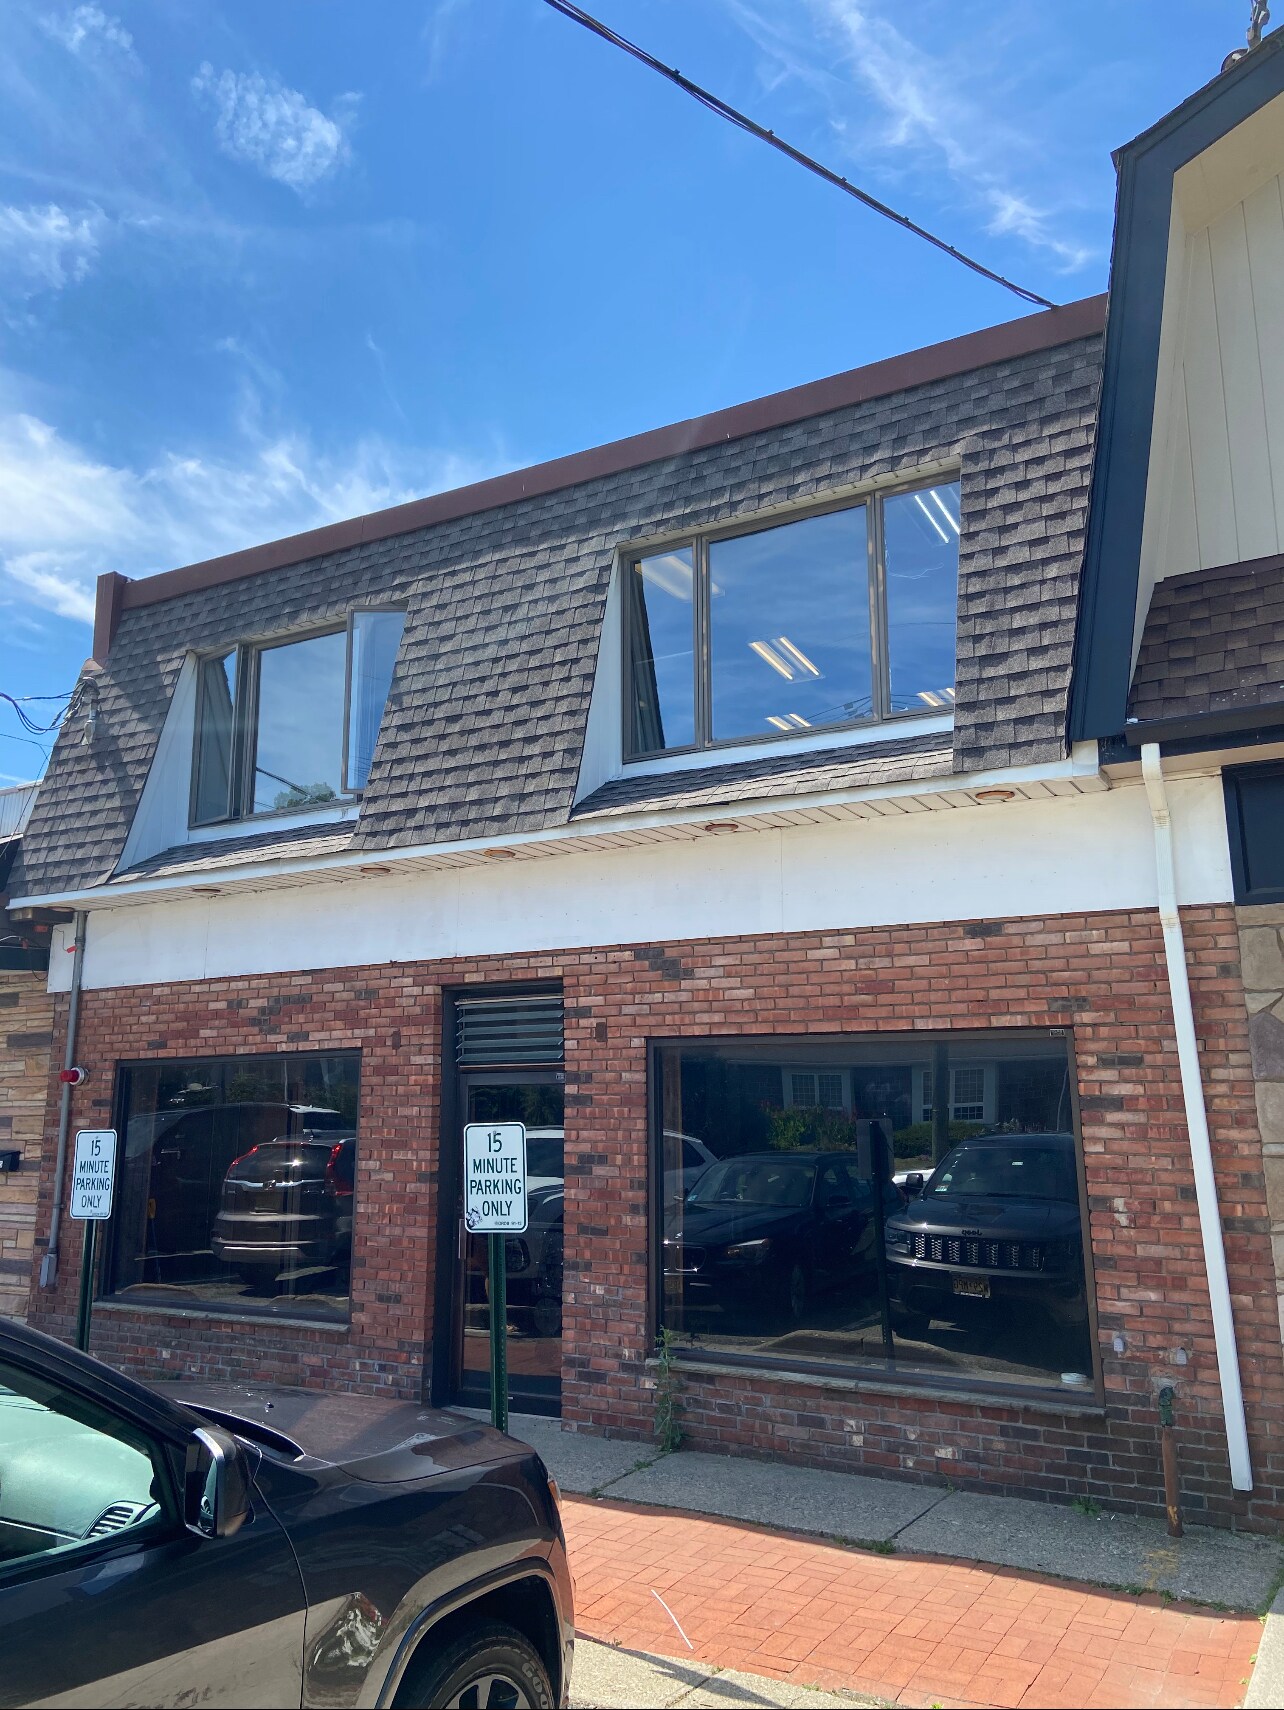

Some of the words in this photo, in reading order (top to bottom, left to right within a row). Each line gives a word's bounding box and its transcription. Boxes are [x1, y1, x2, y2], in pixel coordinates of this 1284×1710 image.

[90, 1139, 102, 1157] 15
[487, 1132, 503, 1153] 15
[79, 1160, 110, 1174] MINUTE
[472, 1157, 518, 1174] MINUTE
[75, 1177, 111, 1191] PARKING
[469, 1178, 522, 1196] PARKING
[81, 1194, 102, 1209] ONLY
[481, 1200, 513, 1217] ONLY
